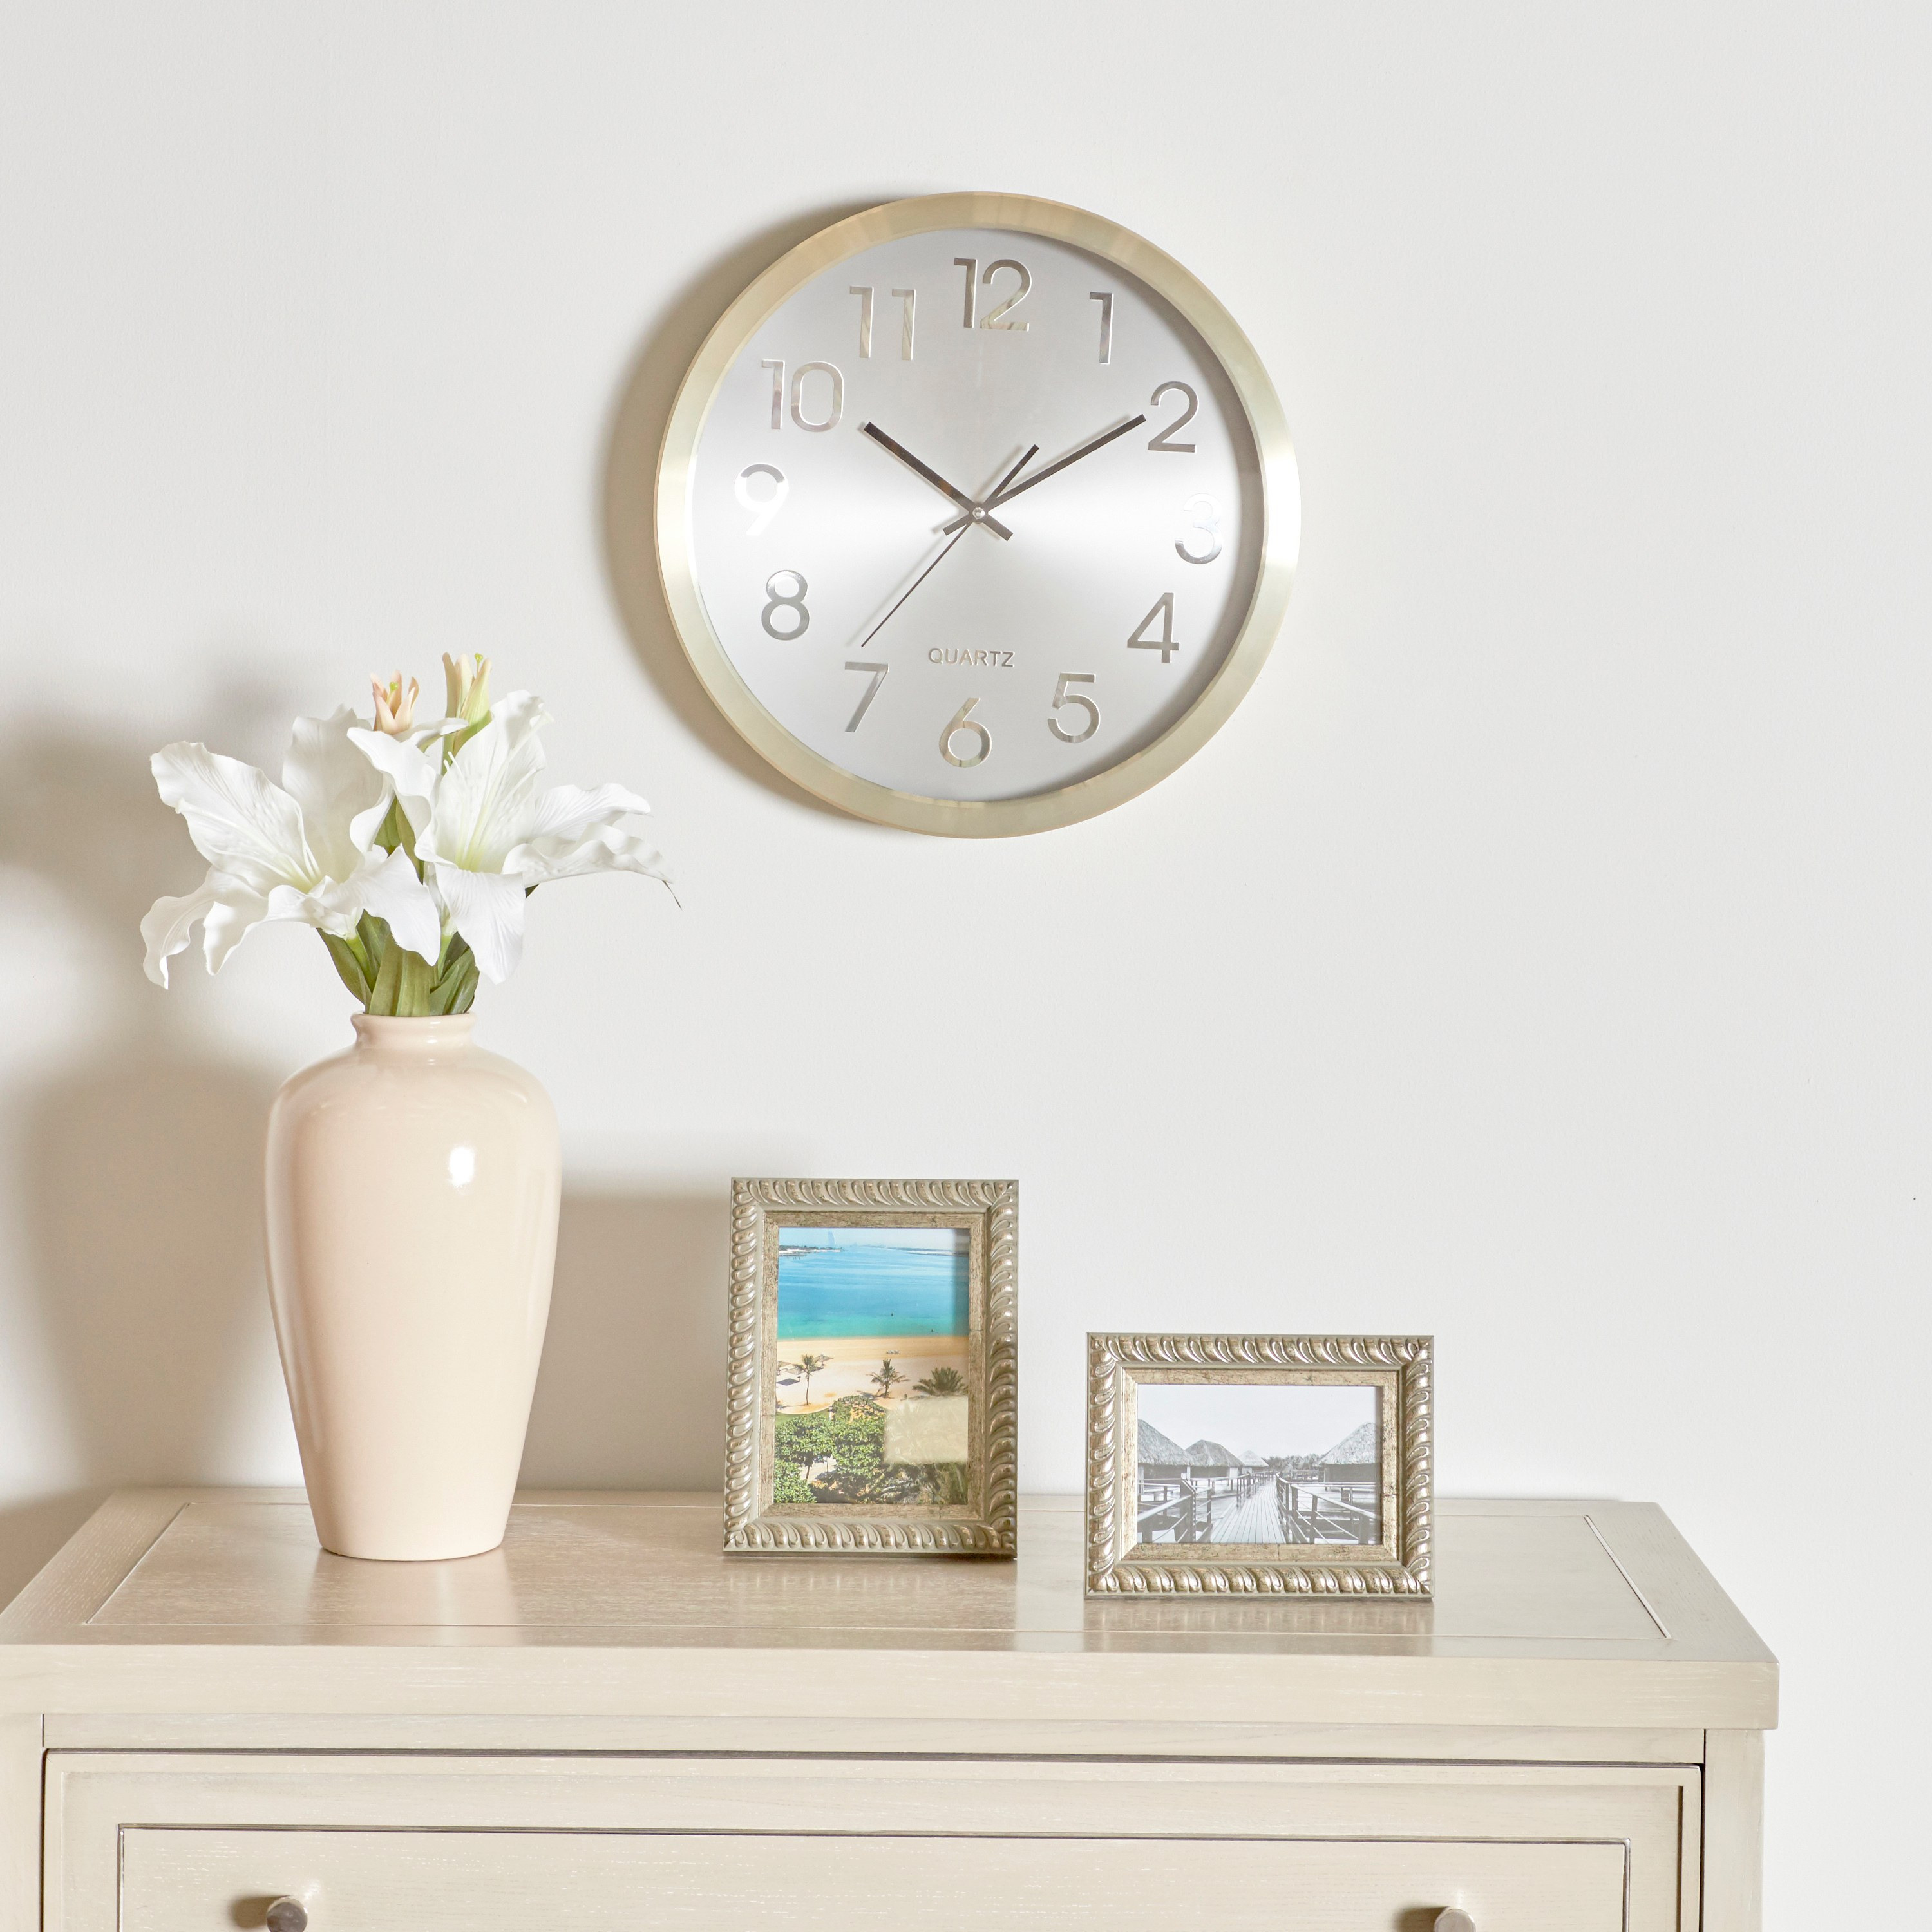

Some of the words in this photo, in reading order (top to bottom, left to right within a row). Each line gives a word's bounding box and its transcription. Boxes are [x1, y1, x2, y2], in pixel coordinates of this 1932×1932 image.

[849, 286, 916, 361] 11
[953, 258, 1032, 332] 12
[1089, 291, 1113, 365] 1
[761, 359, 844, 433] 10
[1147, 381, 1200, 453] 2
[735, 463, 788, 536] 9
[1175, 492, 1222, 565] 3
[761, 569, 810, 641] 8
[1126, 592, 1180, 664] 4
[927, 647, 1015, 668] QUARTZ
[844, 661, 889, 733] 7
[938, 697, 992, 768] 6
[1046, 672, 1101, 744] 5
